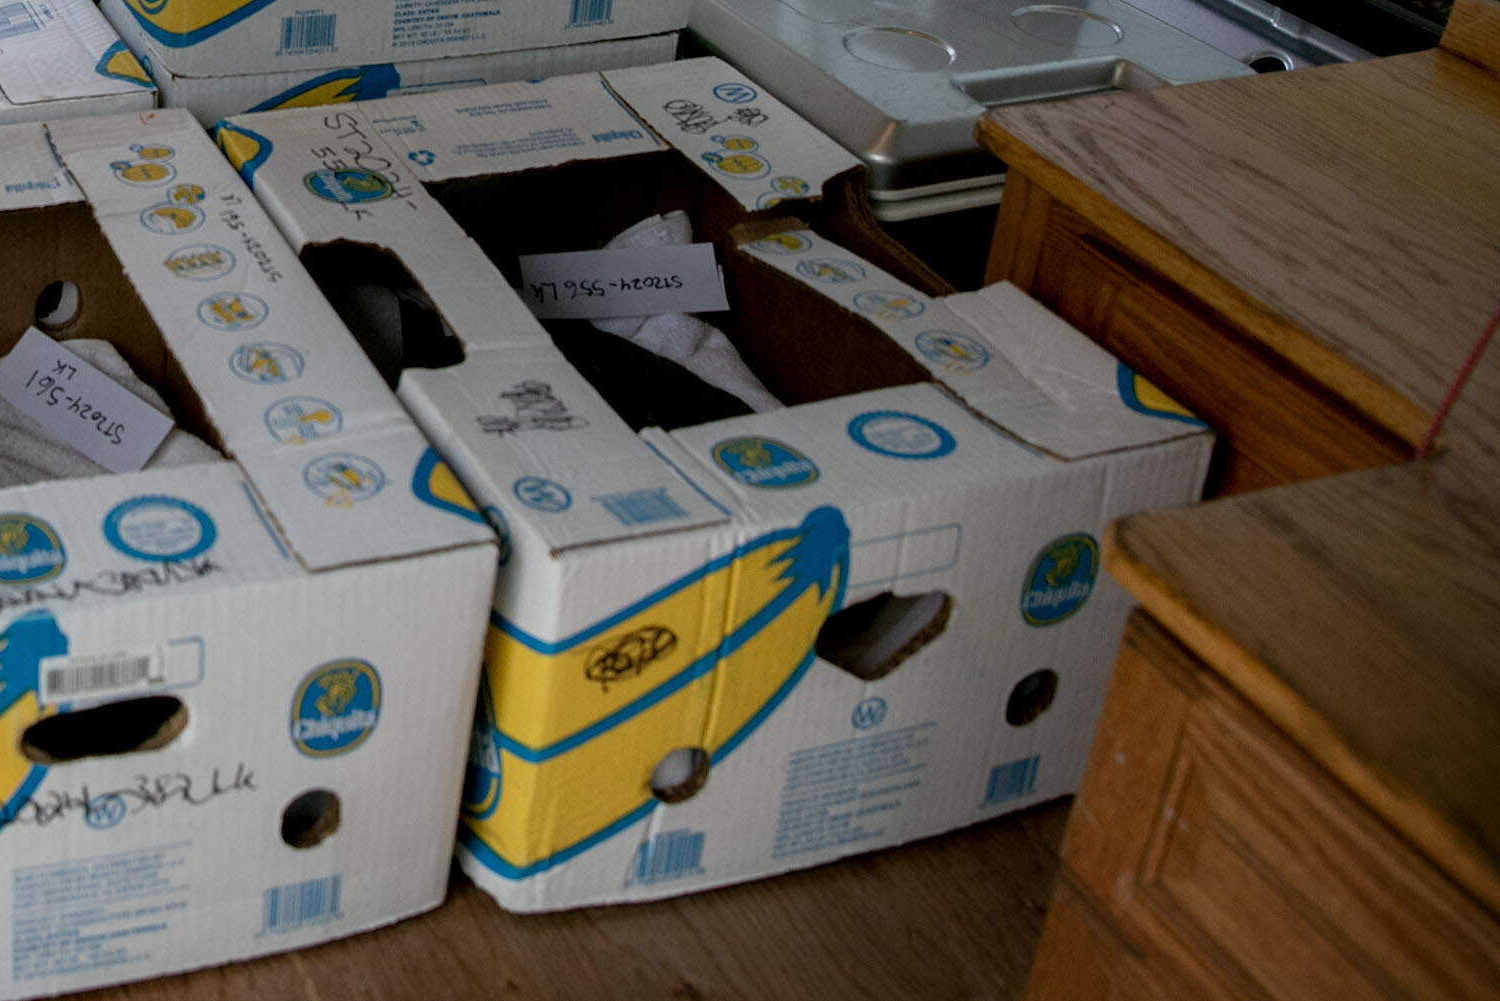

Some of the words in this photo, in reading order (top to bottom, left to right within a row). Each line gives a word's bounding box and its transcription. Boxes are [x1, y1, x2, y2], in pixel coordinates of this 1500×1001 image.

[592, 128, 645, 145] Chiquita
[564, 274, 684, 298] ST2024-556
[51, 358, 77, 382] LK
[24, 369, 126, 446] ST2024-561
[733, 457, 812, 483] Chiquita
[1021, 580, 1092, 609] Chiquita
[293, 709, 380, 747] Chiquita
